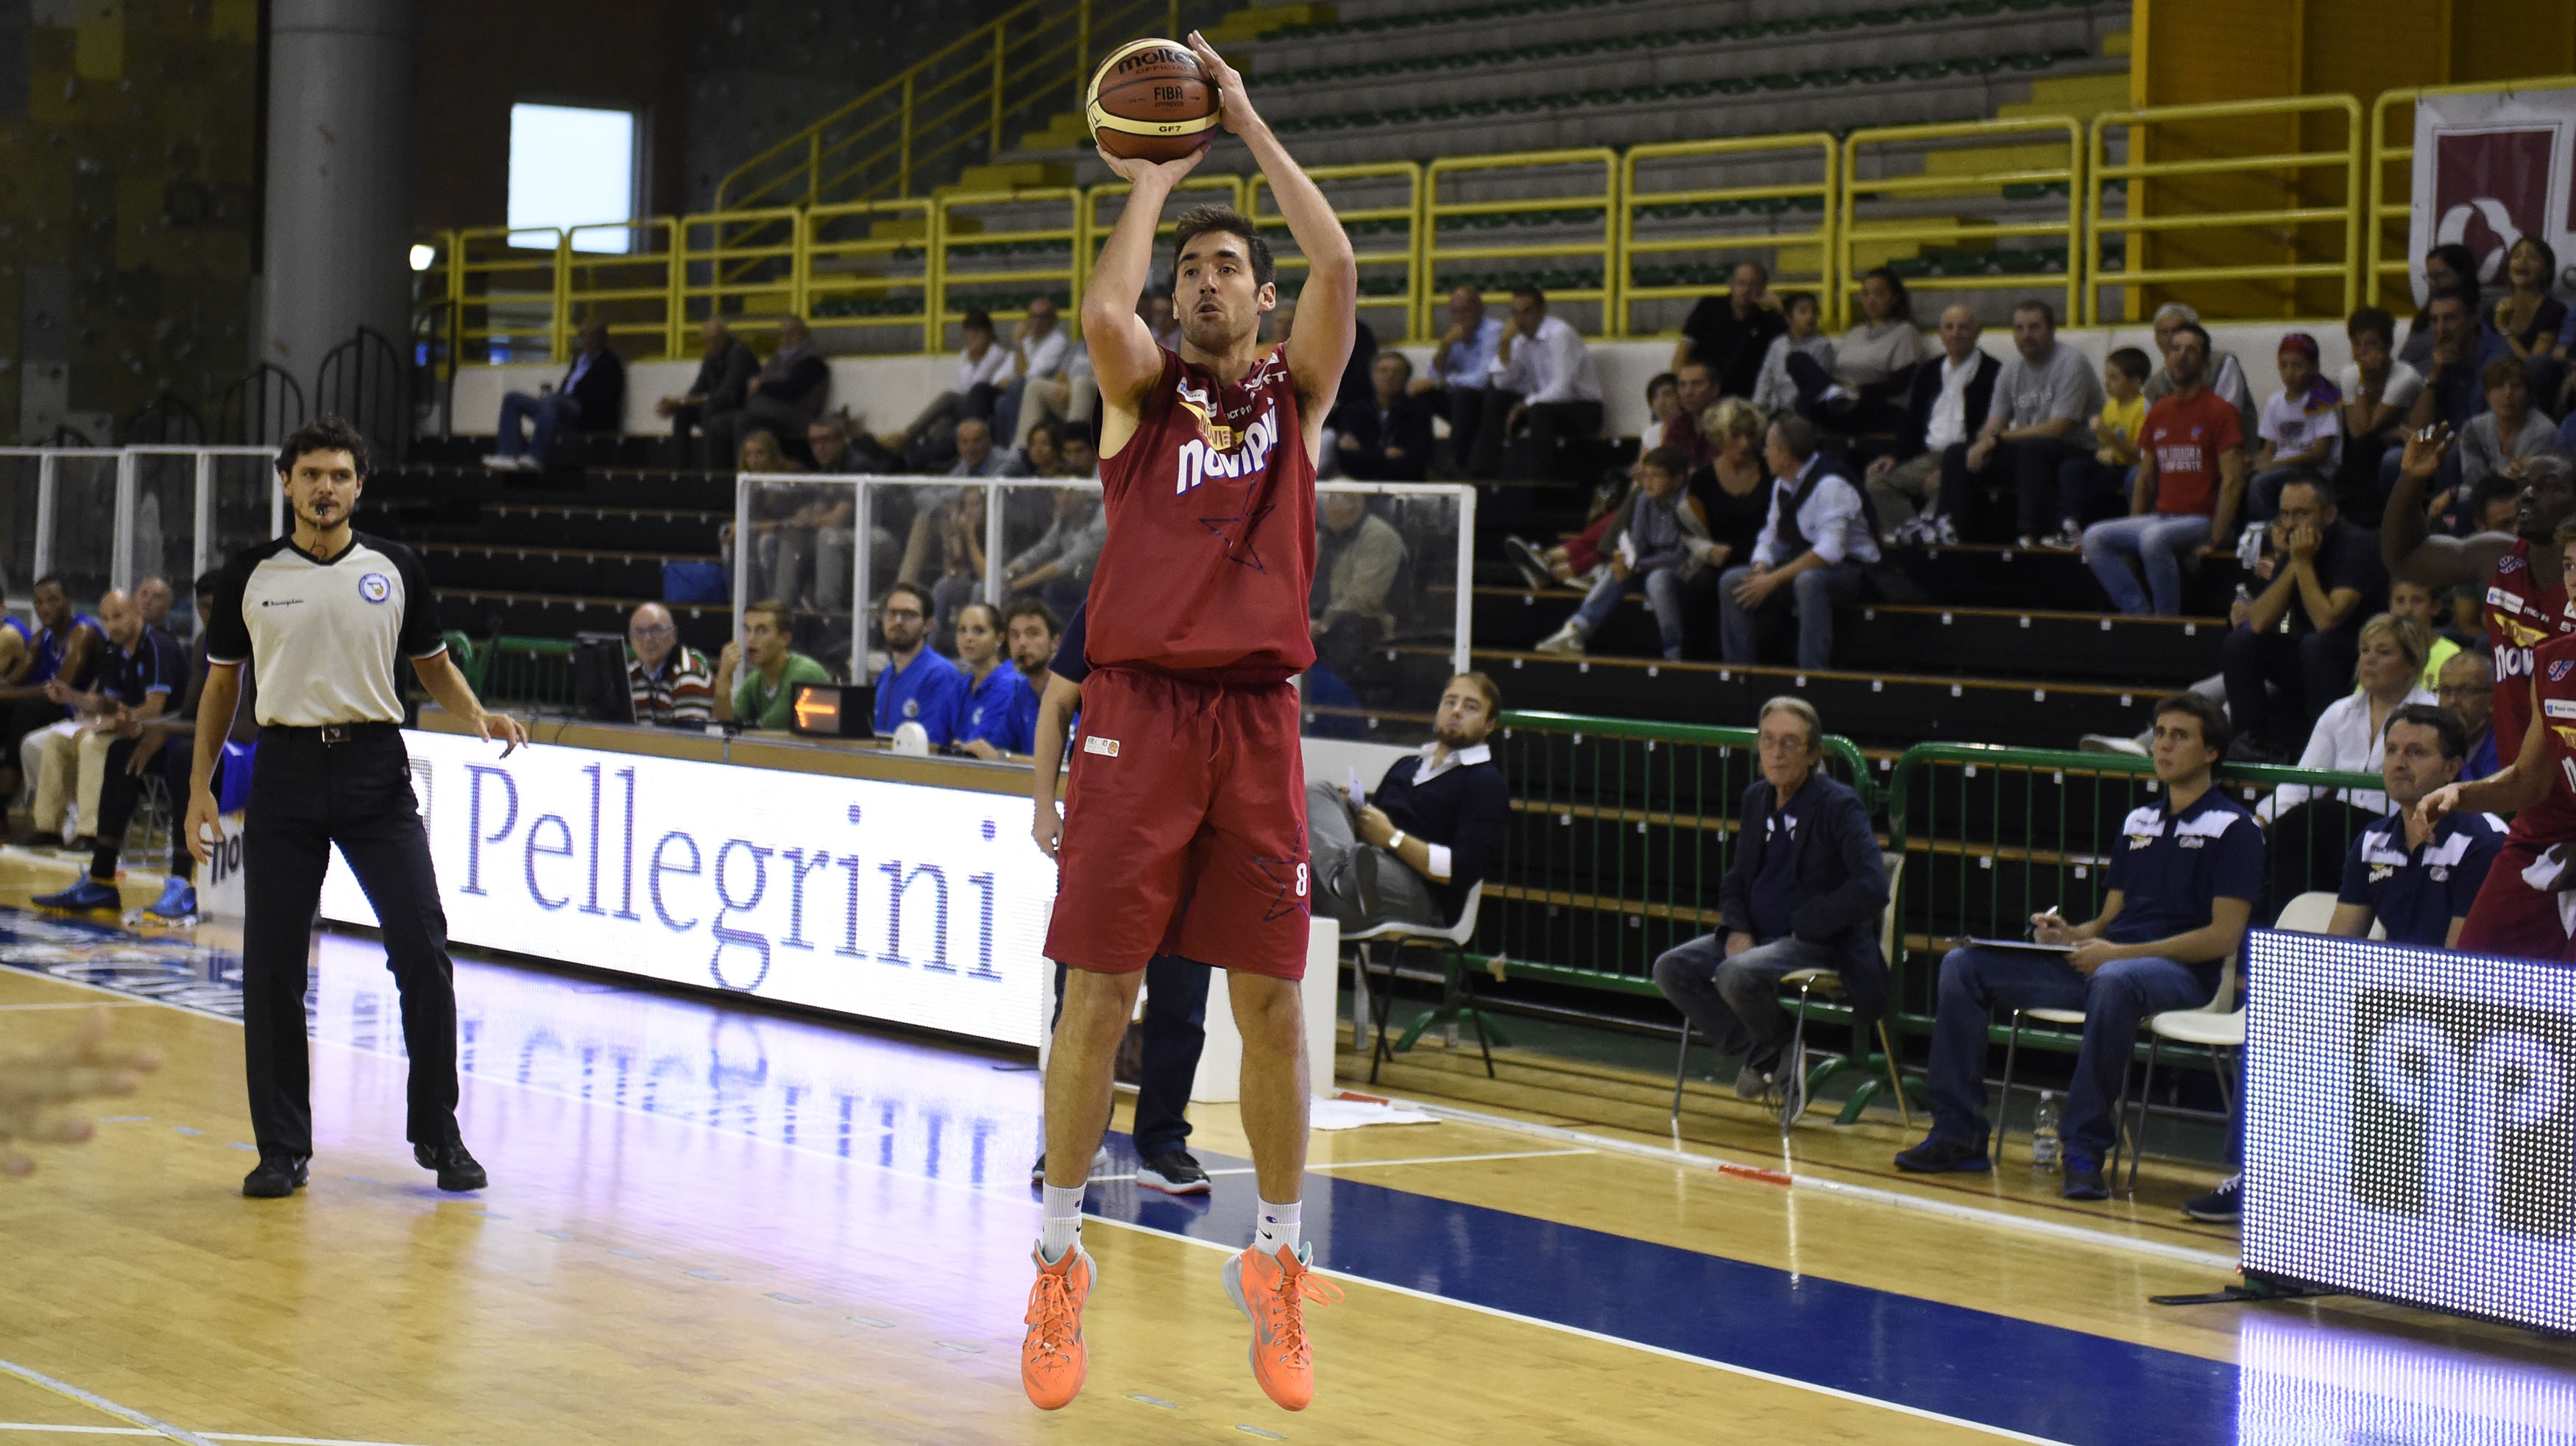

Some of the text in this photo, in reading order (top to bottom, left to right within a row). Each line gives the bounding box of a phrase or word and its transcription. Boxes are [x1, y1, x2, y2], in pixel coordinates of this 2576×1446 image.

[1153, 85, 1183, 101] FIBA
[459, 762, 1002, 993] Pellegrini
[1295, 862, 1308, 897] 8
